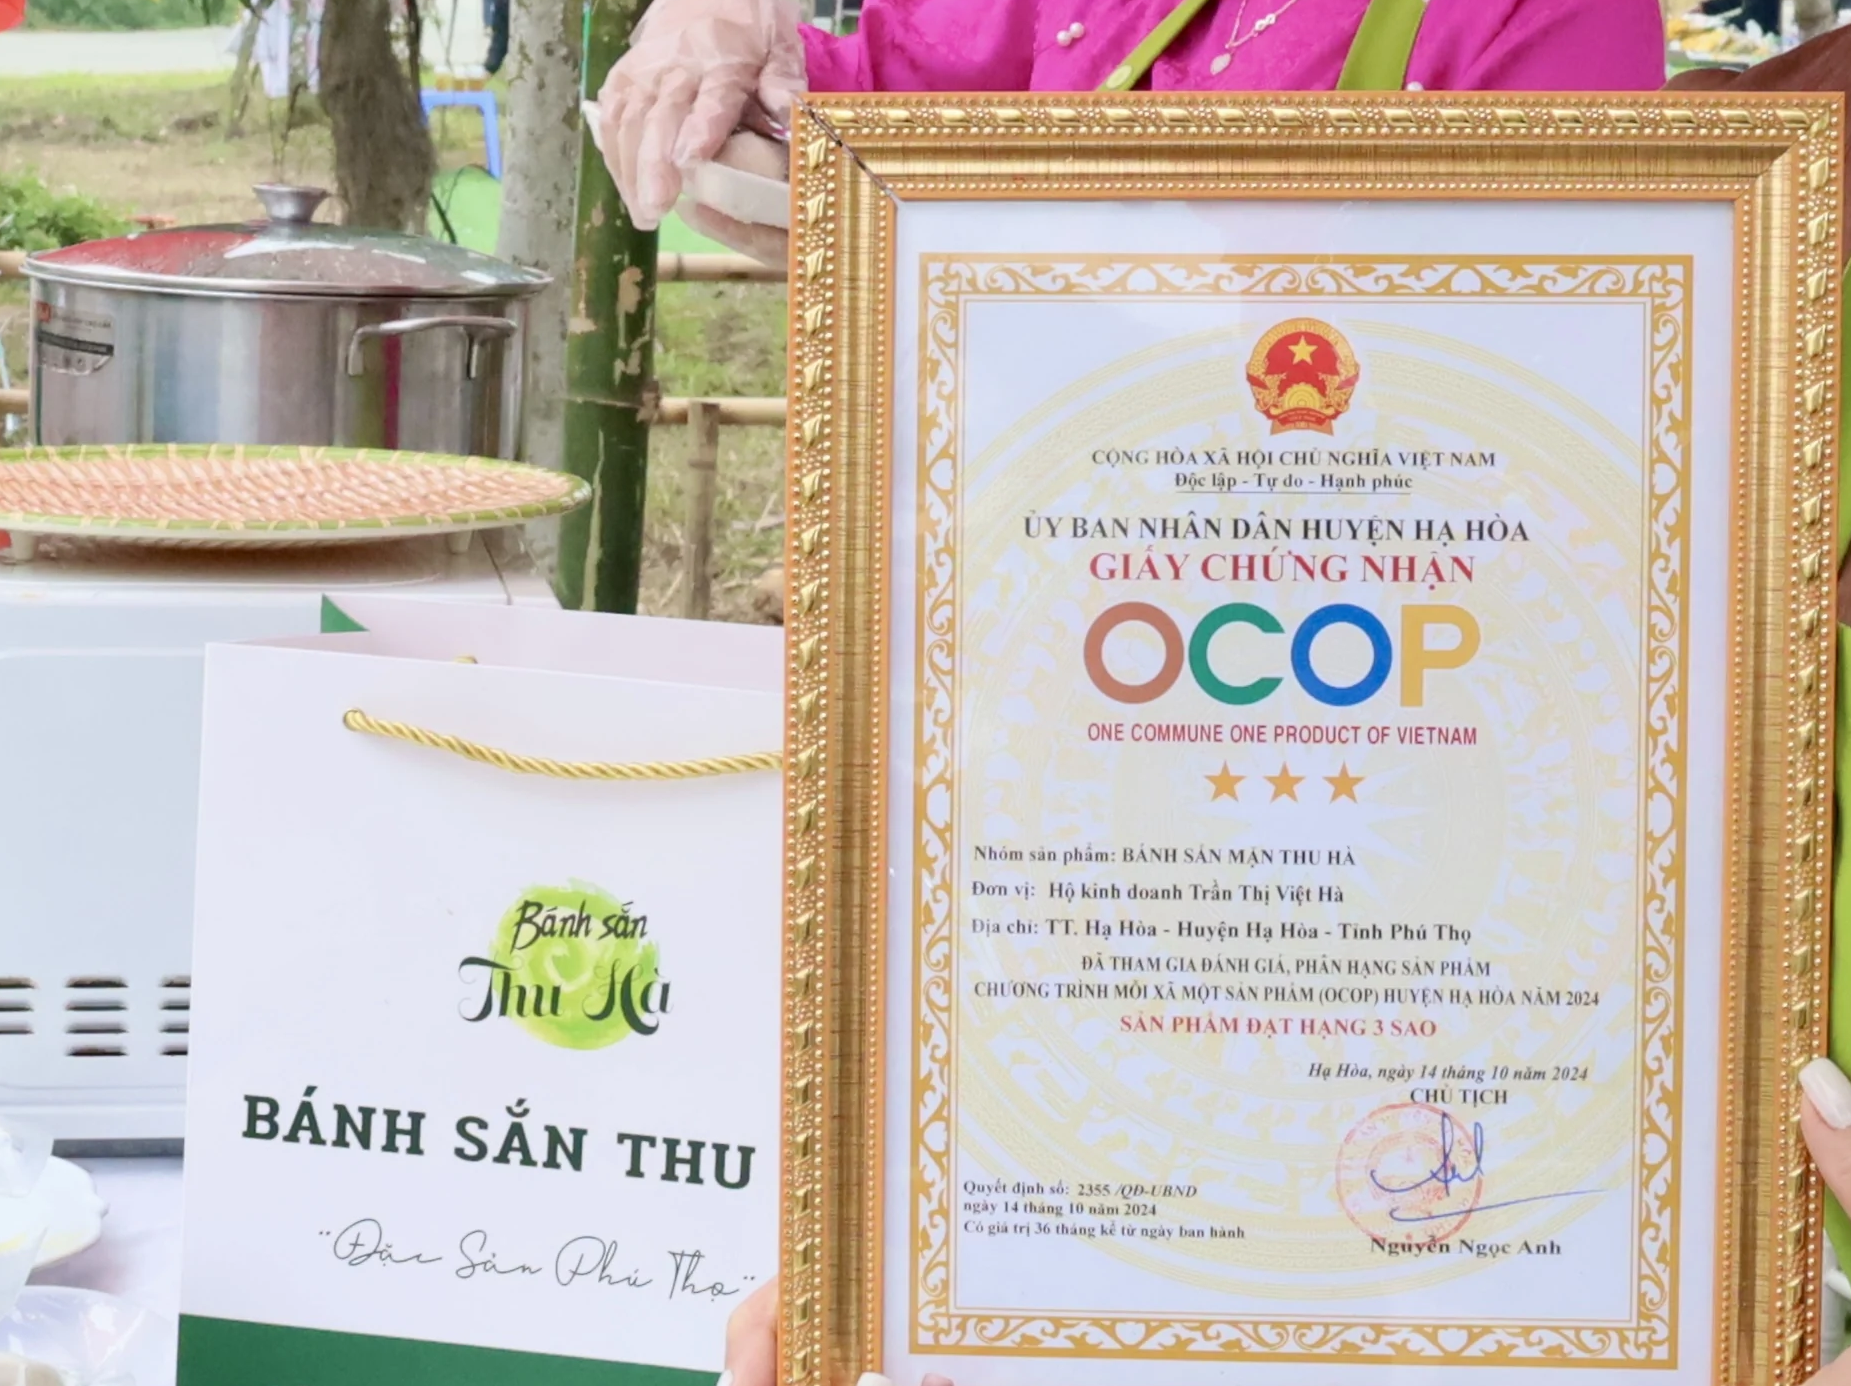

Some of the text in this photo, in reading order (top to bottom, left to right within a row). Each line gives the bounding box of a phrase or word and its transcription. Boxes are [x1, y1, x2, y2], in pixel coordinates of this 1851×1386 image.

[1092, 447, 1495, 470] CỘNG HÒA XÃ HỘI CHỦ NGHĨA VIỆT NAM
[1175, 473, 1413, 492] Độc lập Tự do Hạnh phúc
[1023, 510, 1530, 547] ỦY BAN NHÂN DÂN HUYỆN HẠ HÒA
[1089, 545, 1475, 591] GIẤY CHỨNG NHẬN
[1083, 601, 1482, 708] OCOP
[1087, 723, 1477, 745] ONE COMMUNE ONE PRODUCT OF VIETNAM
[973, 846, 1023, 862] Nhóm
[1122, 843, 1178, 863] BÁNH
[1279, 849, 1321, 865] THU
[1327, 845, 1356, 865] HÀ
[971, 879, 1344, 906] Đơn vị: Hộ kinh doanh Trần Thị Việt Hà
[510, 900, 648, 954] Bánh sắn
[971, 918, 1001, 937] Địa
[1045, 919, 1079, 936] TT.
[1085, 920, 1112, 941] Hạ
[1119, 920, 1157, 937] Hòa
[1177, 921, 1238, 943] Huyện
[1246, 922, 1273, 943] Hạ
[1280, 922, 1319, 940] Hòa
[1390, 923, 1427, 941] Phú
[1433, 923, 1472, 946] Thọ
[458, 955, 674, 1036] Thu Hà
[1246, 1018, 1293, 1038] ĐẠT
[1300, 1018, 1366, 1040] HẠNG
[1373, 1019, 1384, 1036] 3
[1390, 1019, 1437, 1037] SAO
[1410, 1084, 1508, 1108] CHỦ TỊCH
[241, 1086, 757, 1190] BÁNH SẮN THU
[964, 1178, 1007, 1195] Quyết
[1012, 1180, 1044, 1196] định
[1077, 1183, 1111, 1196] 2355
[1459, 1239, 1511, 1257] Ngọc
[1518, 1239, 1562, 1256] Anh
